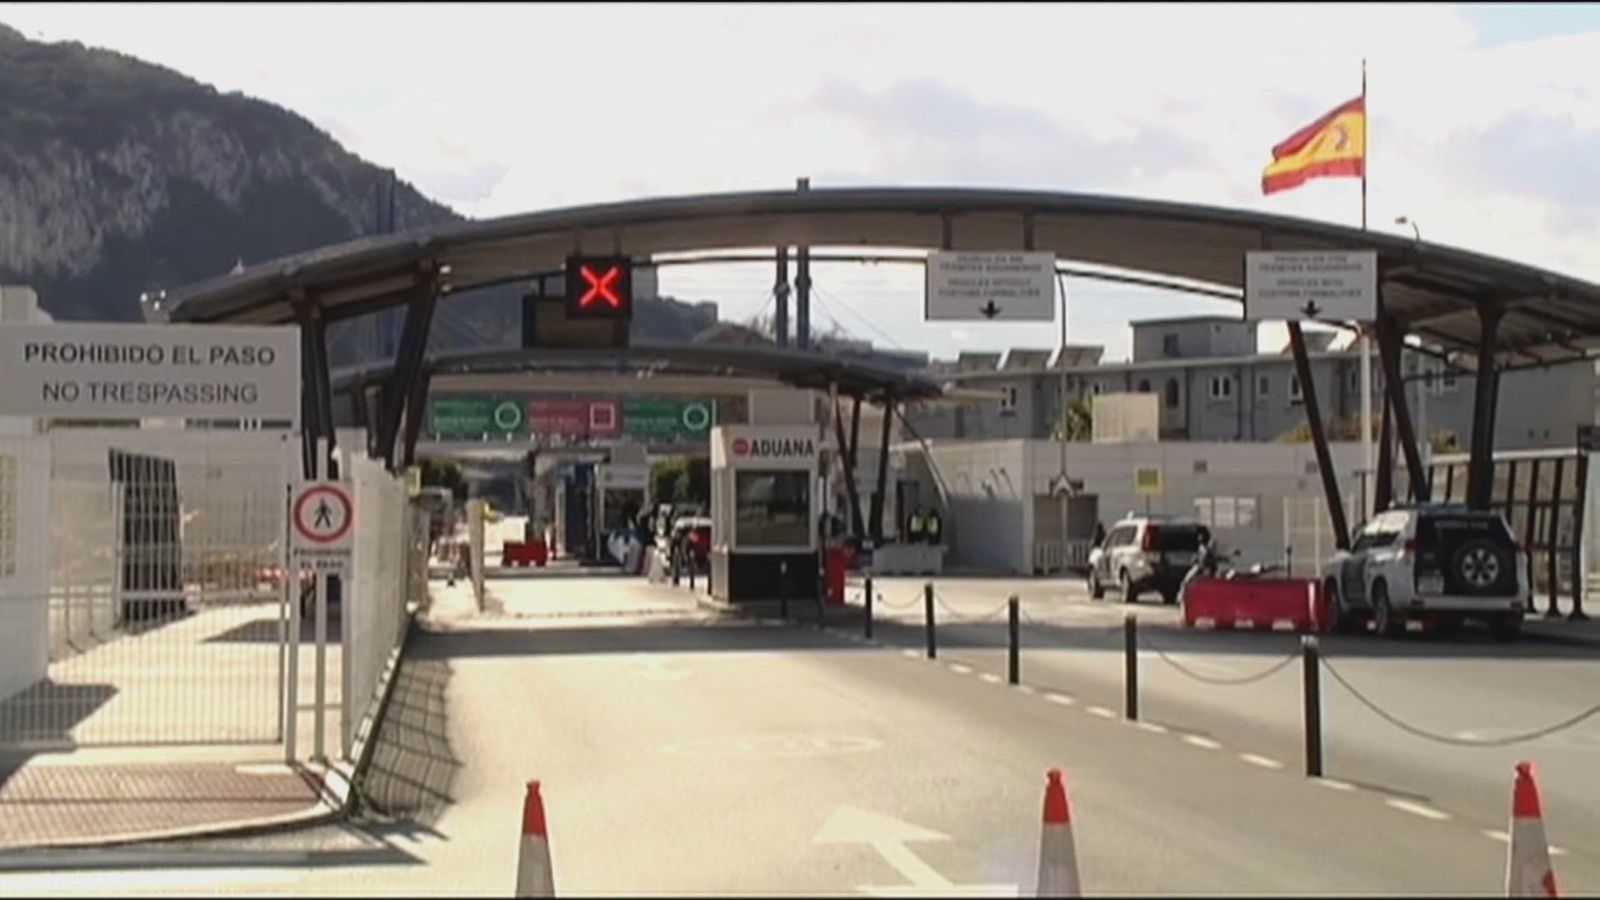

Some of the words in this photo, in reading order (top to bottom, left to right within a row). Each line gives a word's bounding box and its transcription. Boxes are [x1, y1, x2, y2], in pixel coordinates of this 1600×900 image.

[24, 343, 164, 365] PROHIBIDO
[172, 345, 202, 365] EL
[209, 346, 275, 366] PASO
[42, 381, 80, 402] NO
[87, 382, 258, 405] TRESPASSING
[751, 439, 814, 456] ADUANA
